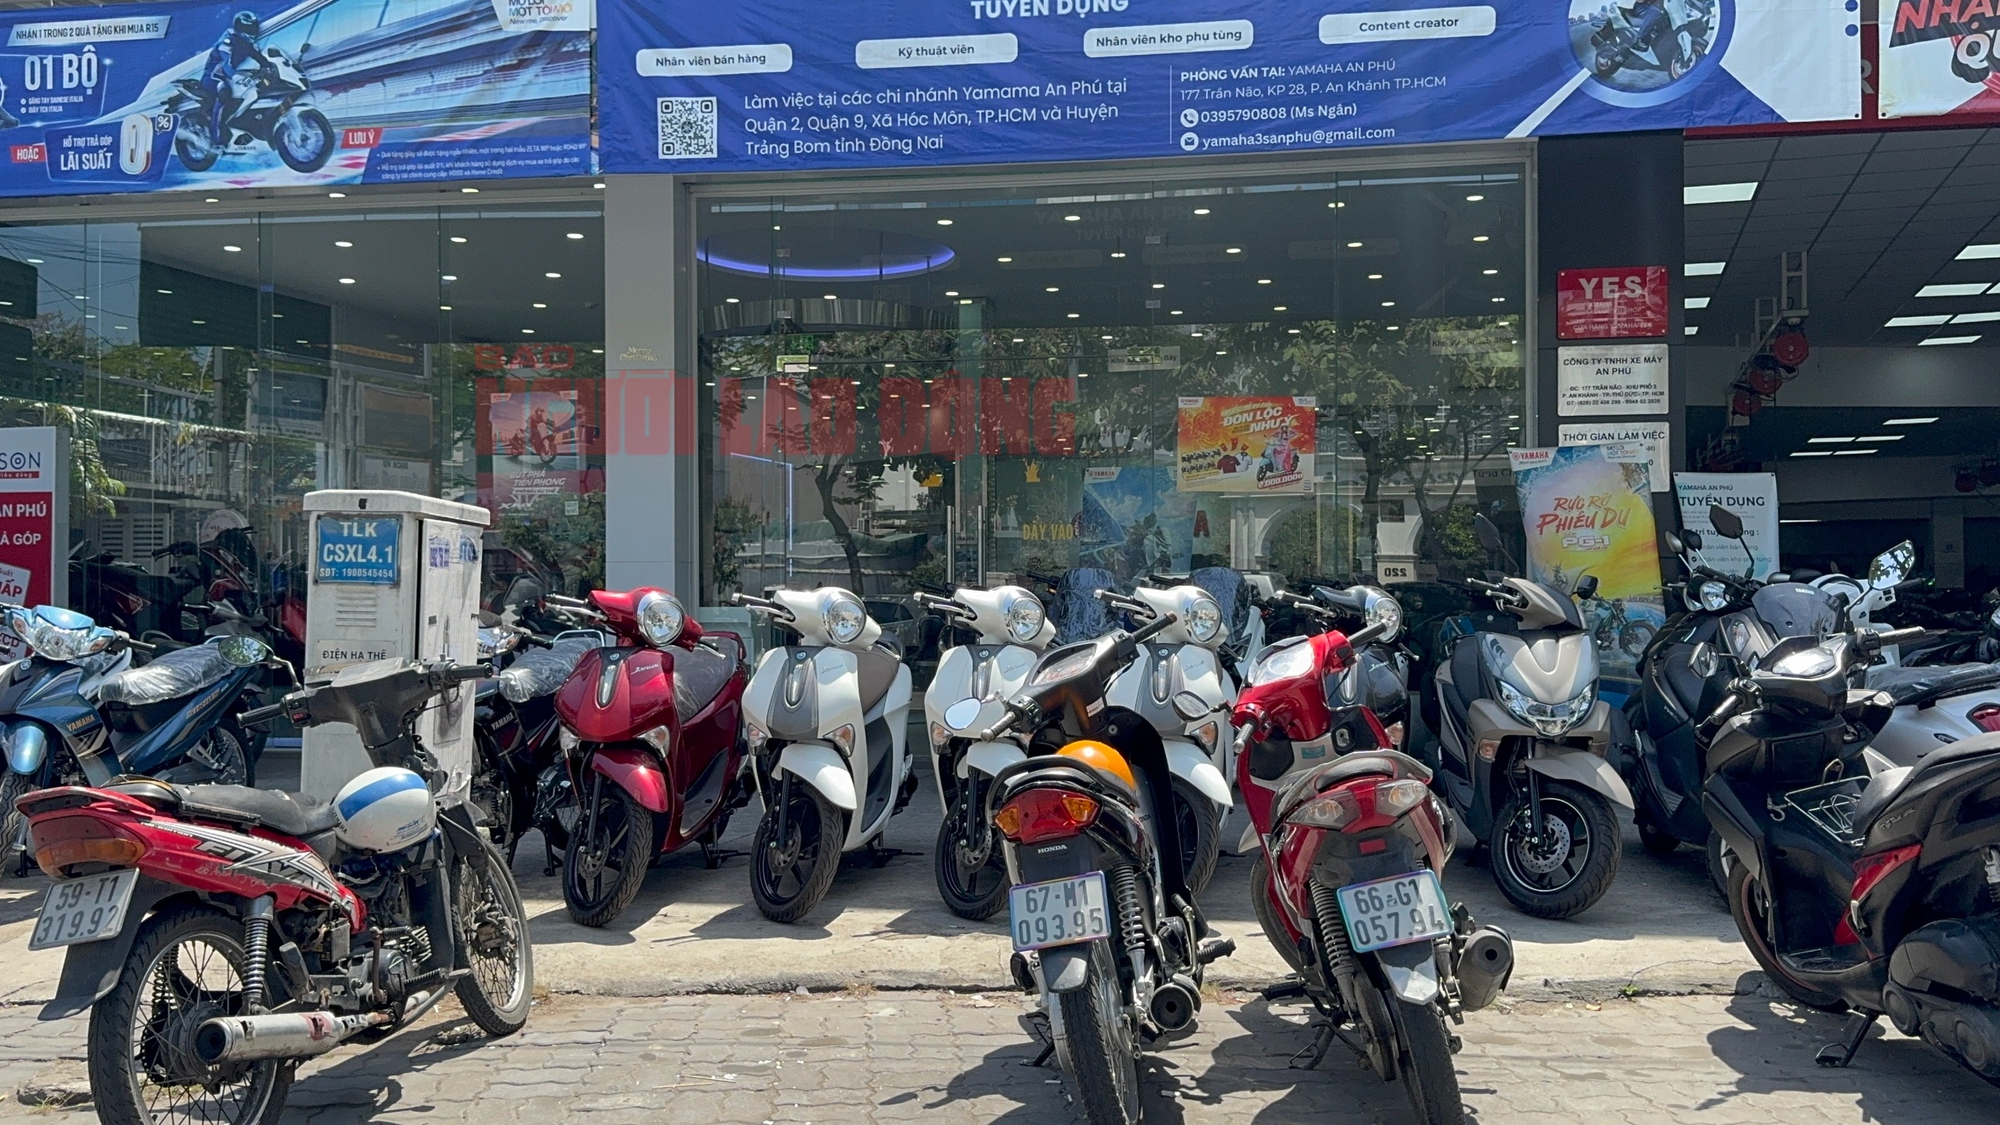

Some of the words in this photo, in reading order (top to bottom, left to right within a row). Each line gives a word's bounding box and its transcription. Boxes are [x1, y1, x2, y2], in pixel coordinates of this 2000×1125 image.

[39, 30, 43, 38] 1
[43, 29, 69, 38] TRONG
[70, 28, 74, 36] 2
[75, 26, 91, 36] QUÀ
[92, 24, 112, 37] TẶNG
[114, 25, 126, 34] KHI
[128, 24, 144, 34] MUA
[146, 22, 159, 32] R15
[1359, 20, 1410, 32] Content
[1414, 18, 1459, 28] creator
[1096, 36, 1128, 47] Nhân
[1131, 34, 1156, 45] viên
[1159, 33, 1183, 44] kho
[1186, 32, 1209, 44] phụ
[1213, 30, 1242, 42] tùng
[898, 47, 912, 59] Kỹ
[915, 46, 948, 58] thuật
[950, 44, 975, 55] viên
[656, 56, 685, 67] Nhân
[688, 56, 711, 66] viên
[714, 54, 735, 65] bán
[738, 54, 766, 65] hàng
[24, 54, 53, 90] 01
[63, 44, 98, 95] BỘ
[1180, 68, 1227, 82] PHỎNG
[1230, 65, 1258, 79] VẤN
[1261, 66, 1286, 80] TẠI:
[1288, 63, 1343, 76] YAMAHA
[1346, 62, 1364, 72] AN
[1368, 58, 1396, 72] PHÚ
[744, 96, 778, 110] Làm
[782, 93, 814, 108] việc
[818, 93, 837, 108] tại
[841, 91, 872, 105] các
[876, 89, 901, 104] chi
[906, 87, 958, 103] nhánh
[962, 84, 1040, 100] Yamama
[1045, 82, 1067, 97] An
[1071, 80, 1102, 96] Phú
[1107, 78, 1128, 96] tại
[1180, 89, 1200, 100] 177
[1235, 86, 1264, 98] Não,
[1267, 85, 1286, 96] KP
[1288, 84, 1307, 96] 28,
[1310, 82, 1322, 94] P.
[1325, 82, 1344, 92] An
[1347, 80, 1390, 92] Khánh
[1394, 76, 1446, 90] TP.HCM
[744, 118, 787, 134] Quận
[791, 118, 804, 134] 2,
[808, 114, 849, 131] Quận
[854, 114, 868, 130] 9,
[872, 112, 892, 128] Xã
[897, 111, 929, 128] Hóc
[934, 110, 972, 126] Môn,
[976, 108, 1037, 124] TP.HCM
[1041, 106, 1062, 121] và
[1066, 103, 1119, 124] Huyện
[1200, 107, 1286, 122] 0395790808
[1290, 104, 1314, 120] (Ms
[1318, 102, 1357, 119] Ngân)
[62, 136, 72, 148] HỖ
[73, 136, 86, 148] TRỢ
[86, 134, 99, 146] TRẢ
[100, 134, 113, 146] GÓP
[348, 132, 367, 145] LƯU
[368, 130, 375, 144] Ý
[746, 140, 790, 158] Trảng
[794, 140, 830, 154] Bom
[834, 138, 865, 152] tỉnh
[868, 134, 912, 155] Đồng
[917, 134, 944, 150] Nai
[1202, 126, 1395, 150] yamaha3sanphu@gmail.com
[16, 146, 39, 162] HOẶC
[60, 151, 79, 171] LÃI
[82, 148, 113, 170] SUẤT
[1578, 276, 1642, 299] YES
[1563, 357, 1589, 366] CÔNG
[1643, 356, 1662, 364] MÁY
[1596, 368, 1609, 376] AN
[1612, 366, 1632, 375] PHÚ
[1255, 406, 1282, 420] LỘC
[1563, 432, 1588, 442] THỜI
[1590, 432, 1615, 441] GIAN
[1617, 431, 1640, 441] LÀM
[1642, 430, 1665, 441] VIỆC
[1519, 451, 1550, 460] YAMAHA
[1554, 495, 1585, 512] RỰC
[1588, 492, 1612, 507] RỠ
[1679, 492, 1722, 506] TUYỂN
[1726, 496, 1765, 508] DỤNG
[16, 501, 47, 518] PHÚ
[1600, 507, 1632, 530] DU
[13, 530, 42, 546] GÓP
[340, 522, 378, 538] TLK
[1051, 520, 1074, 540] VÀO
[1561, 534, 1610, 549] PG-1
[322, 543, 392, 563] CSXL4.1
[319, 567, 339, 578] SĐT:
[342, 567, 393, 578] 1900545454
[322, 648, 348, 660] ĐIỆN
[350, 650, 365, 662] HẠ
[368, 649, 387, 660] THẾ
[66, 714, 96, 732] YAMAHA
[490, 712, 514, 730] YAMAHA
[1038, 844, 1068, 854] HONDA
[56, 875, 120, 912] 59-T1
[1025, 880, 1089, 914] 67-M1
[36, 903, 120, 944] 319.92
[1018, 907, 1104, 946] 093.95
[1354, 905, 1444, 946] 057.94
